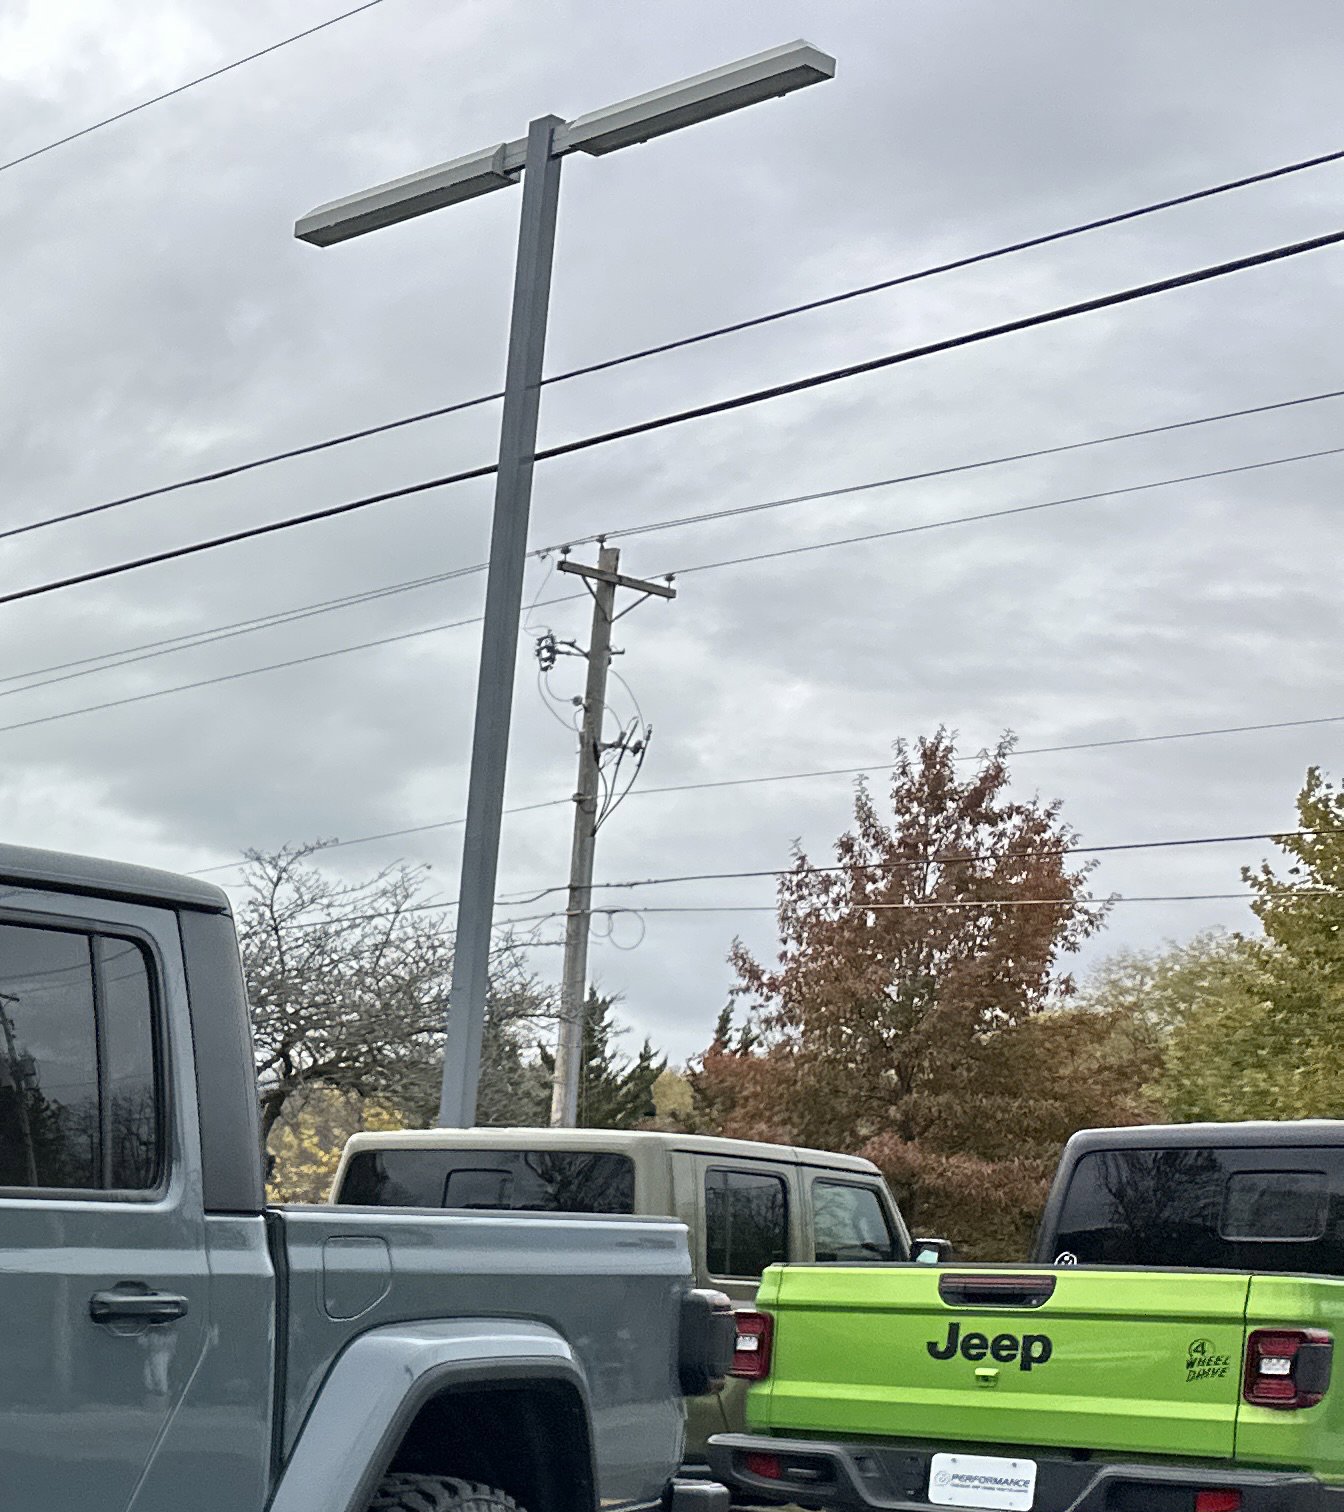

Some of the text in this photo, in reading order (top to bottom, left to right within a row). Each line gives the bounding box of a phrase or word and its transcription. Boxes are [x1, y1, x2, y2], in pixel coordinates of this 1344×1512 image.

[926, 1321, 1053, 1372] Jeep
[1192, 1341, 1206, 1356] 4
[1186, 1355, 1231, 1369] WHEEL
[951, 1473, 1031, 1488] PERFORMANCE
